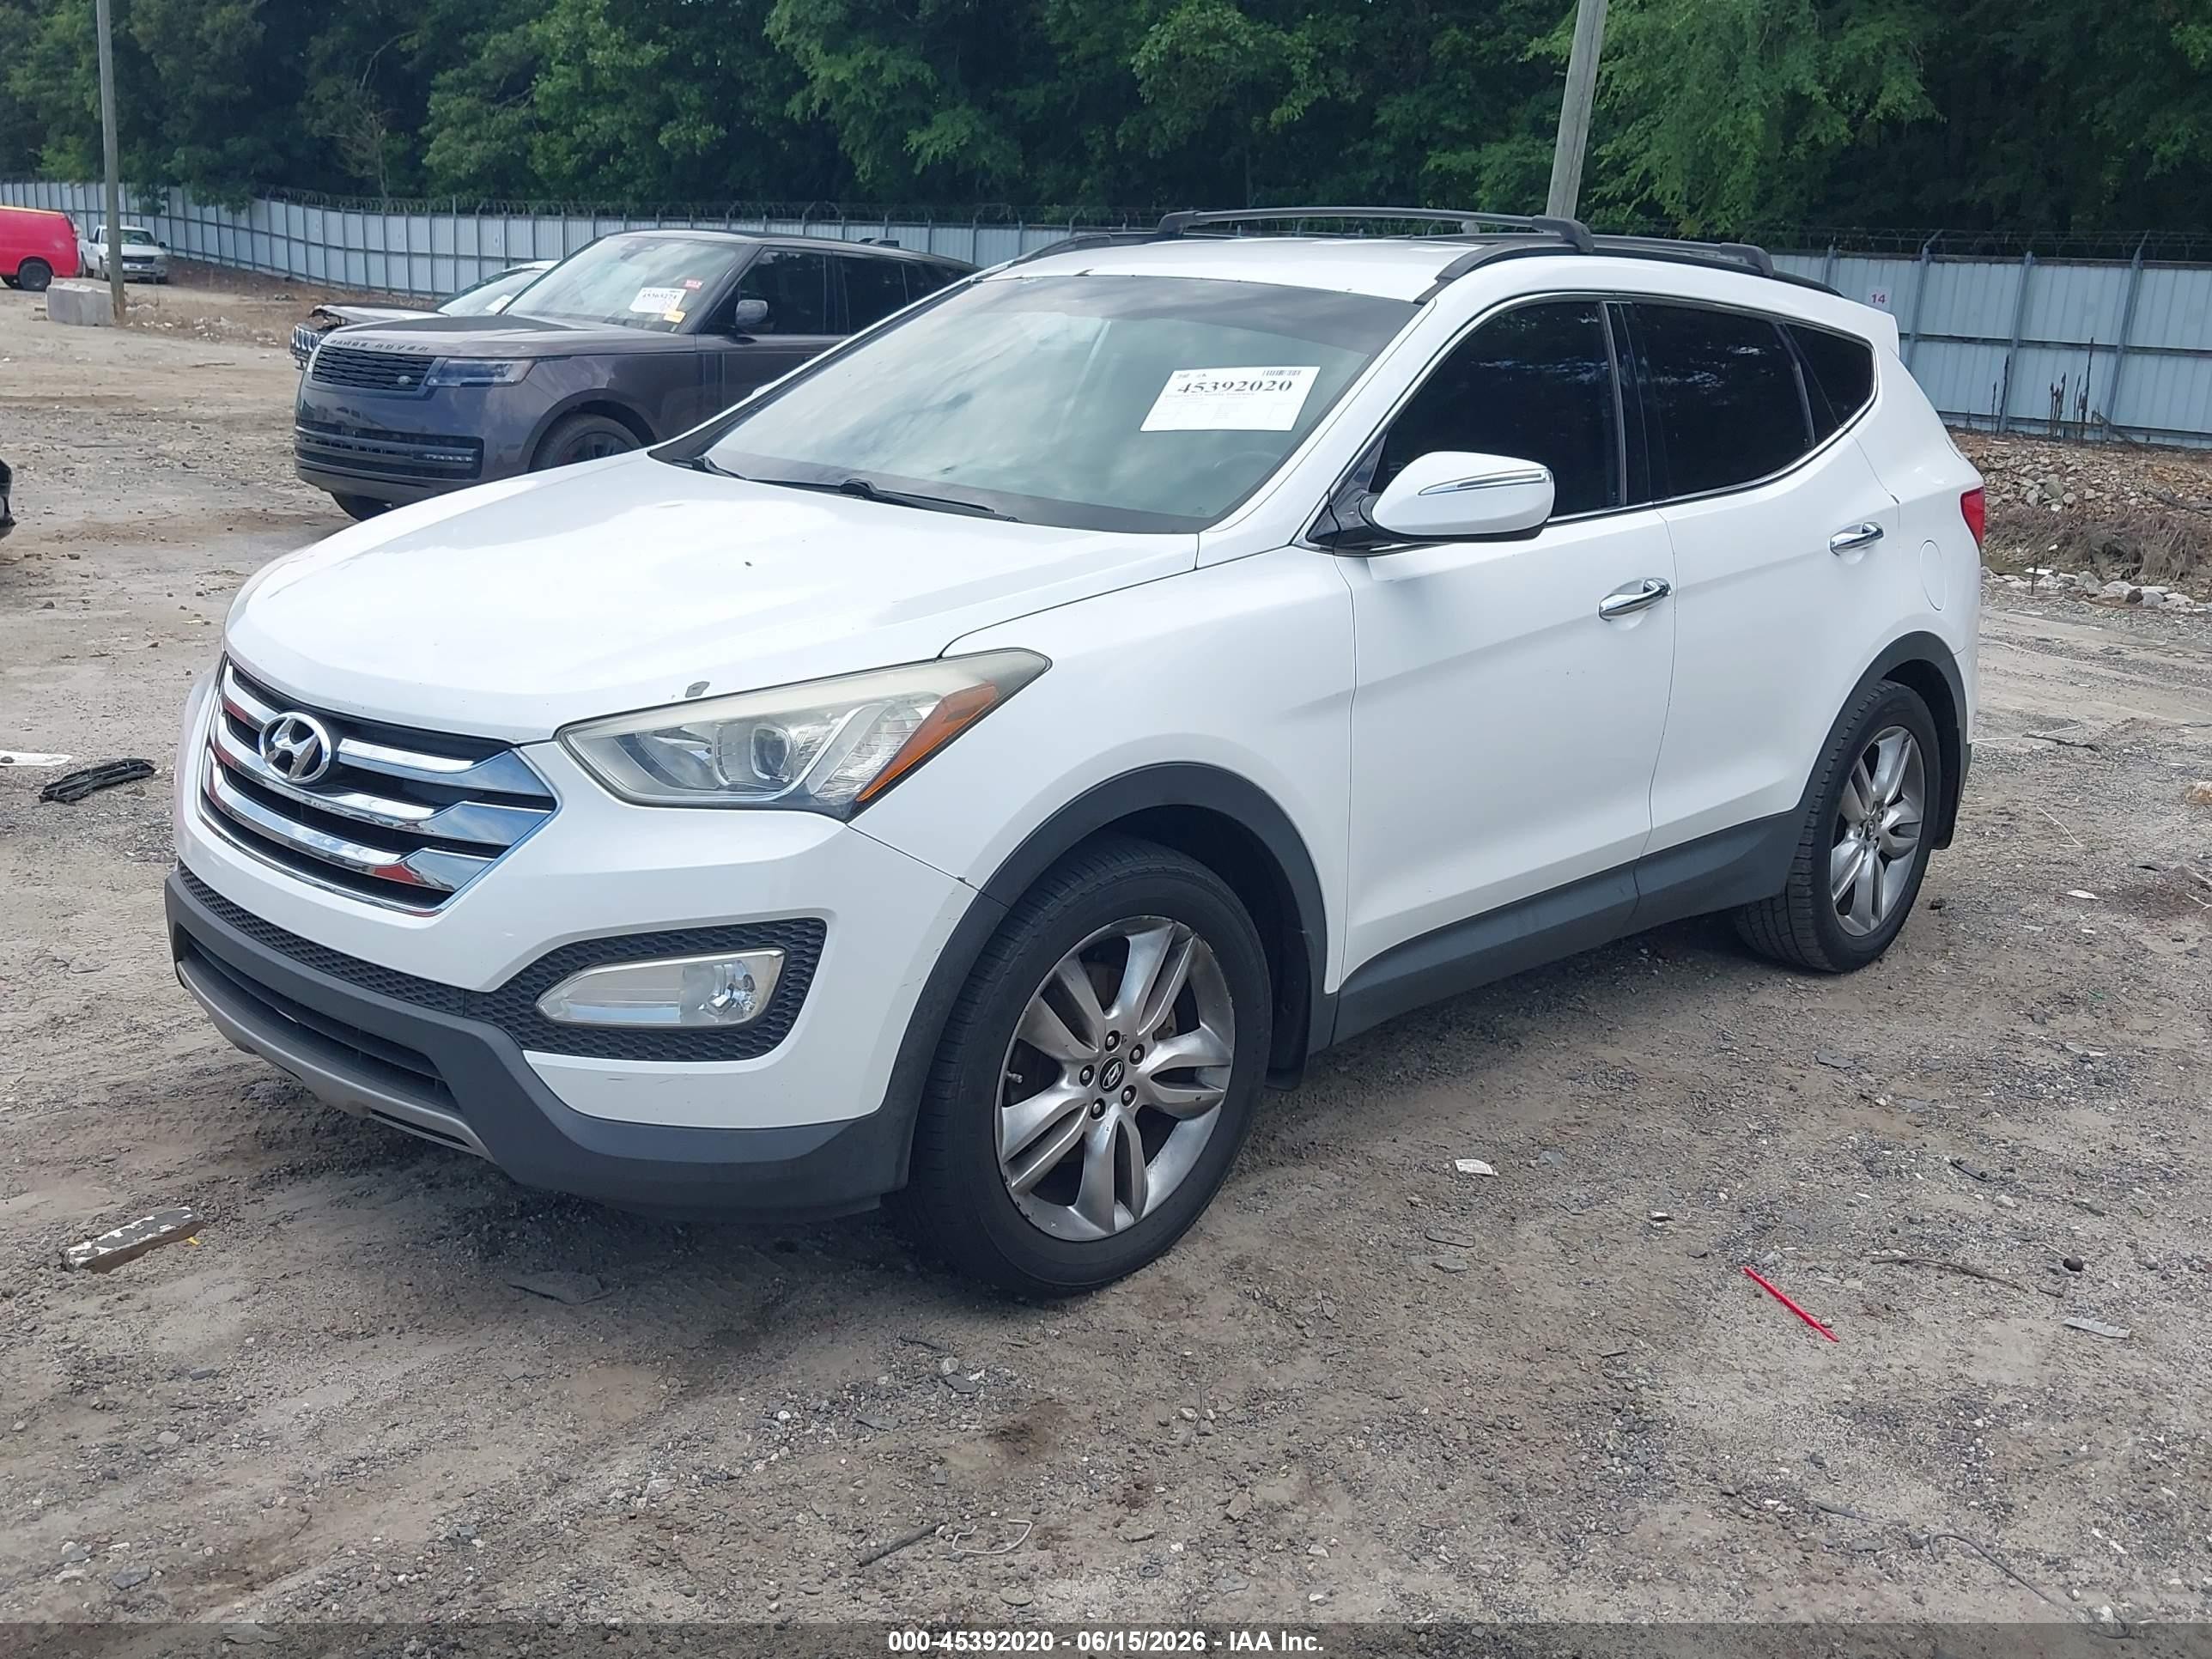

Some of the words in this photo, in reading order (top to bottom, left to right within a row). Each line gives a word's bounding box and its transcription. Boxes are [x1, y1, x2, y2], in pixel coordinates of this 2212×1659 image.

[1871, 294, 1886, 304] 14
[330, 339, 369, 348] RANGE
[374, 343, 429, 351] ROVER
[1176, 380, 1293, 394] 45392020
